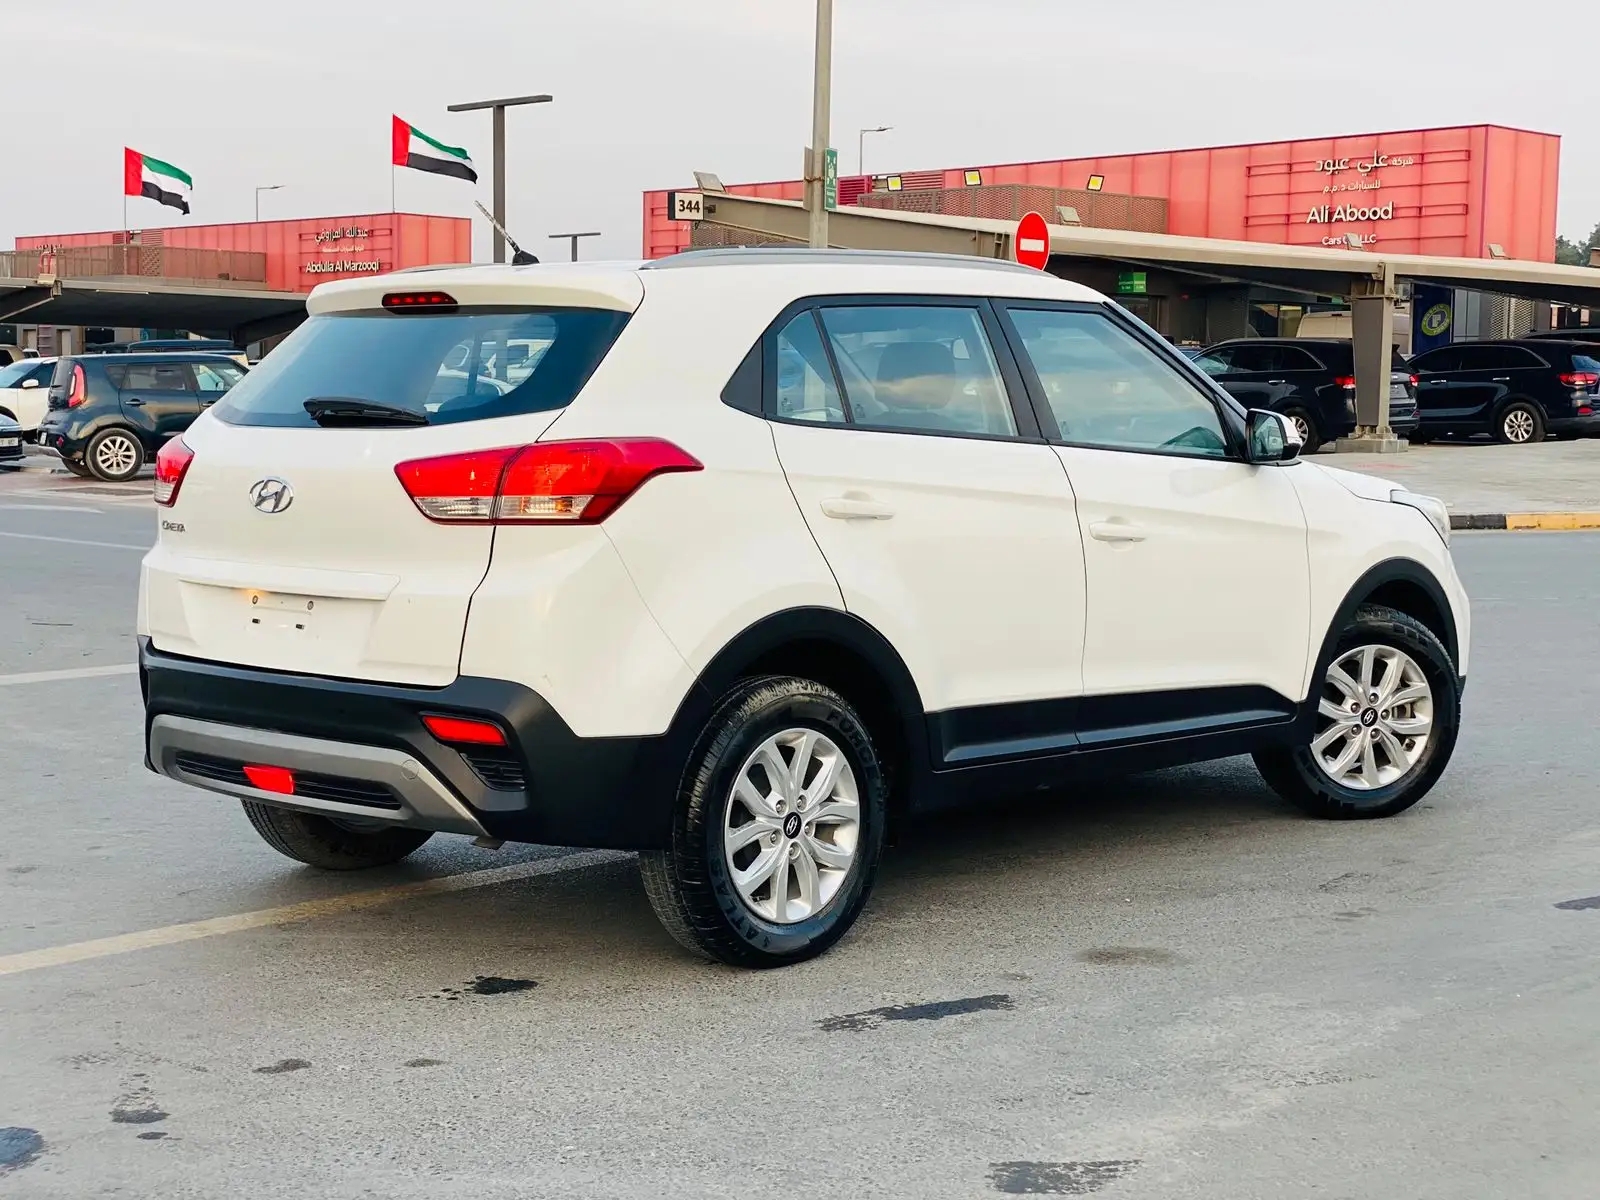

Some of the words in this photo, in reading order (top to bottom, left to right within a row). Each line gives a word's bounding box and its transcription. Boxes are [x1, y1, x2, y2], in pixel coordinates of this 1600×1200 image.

[1314, 157, 1350, 176] عبود
[1357, 149, 1388, 177] علي
[678, 199, 701, 213] 344
[1306, 205, 1330, 224] Ali
[1331, 201, 1394, 223] Abood
[1322, 236, 1342, 246] Cars
[305, 260, 334, 273] Abdulla
[335, 259, 344, 272] Al
[344, 257, 380, 273] Marzooqi
